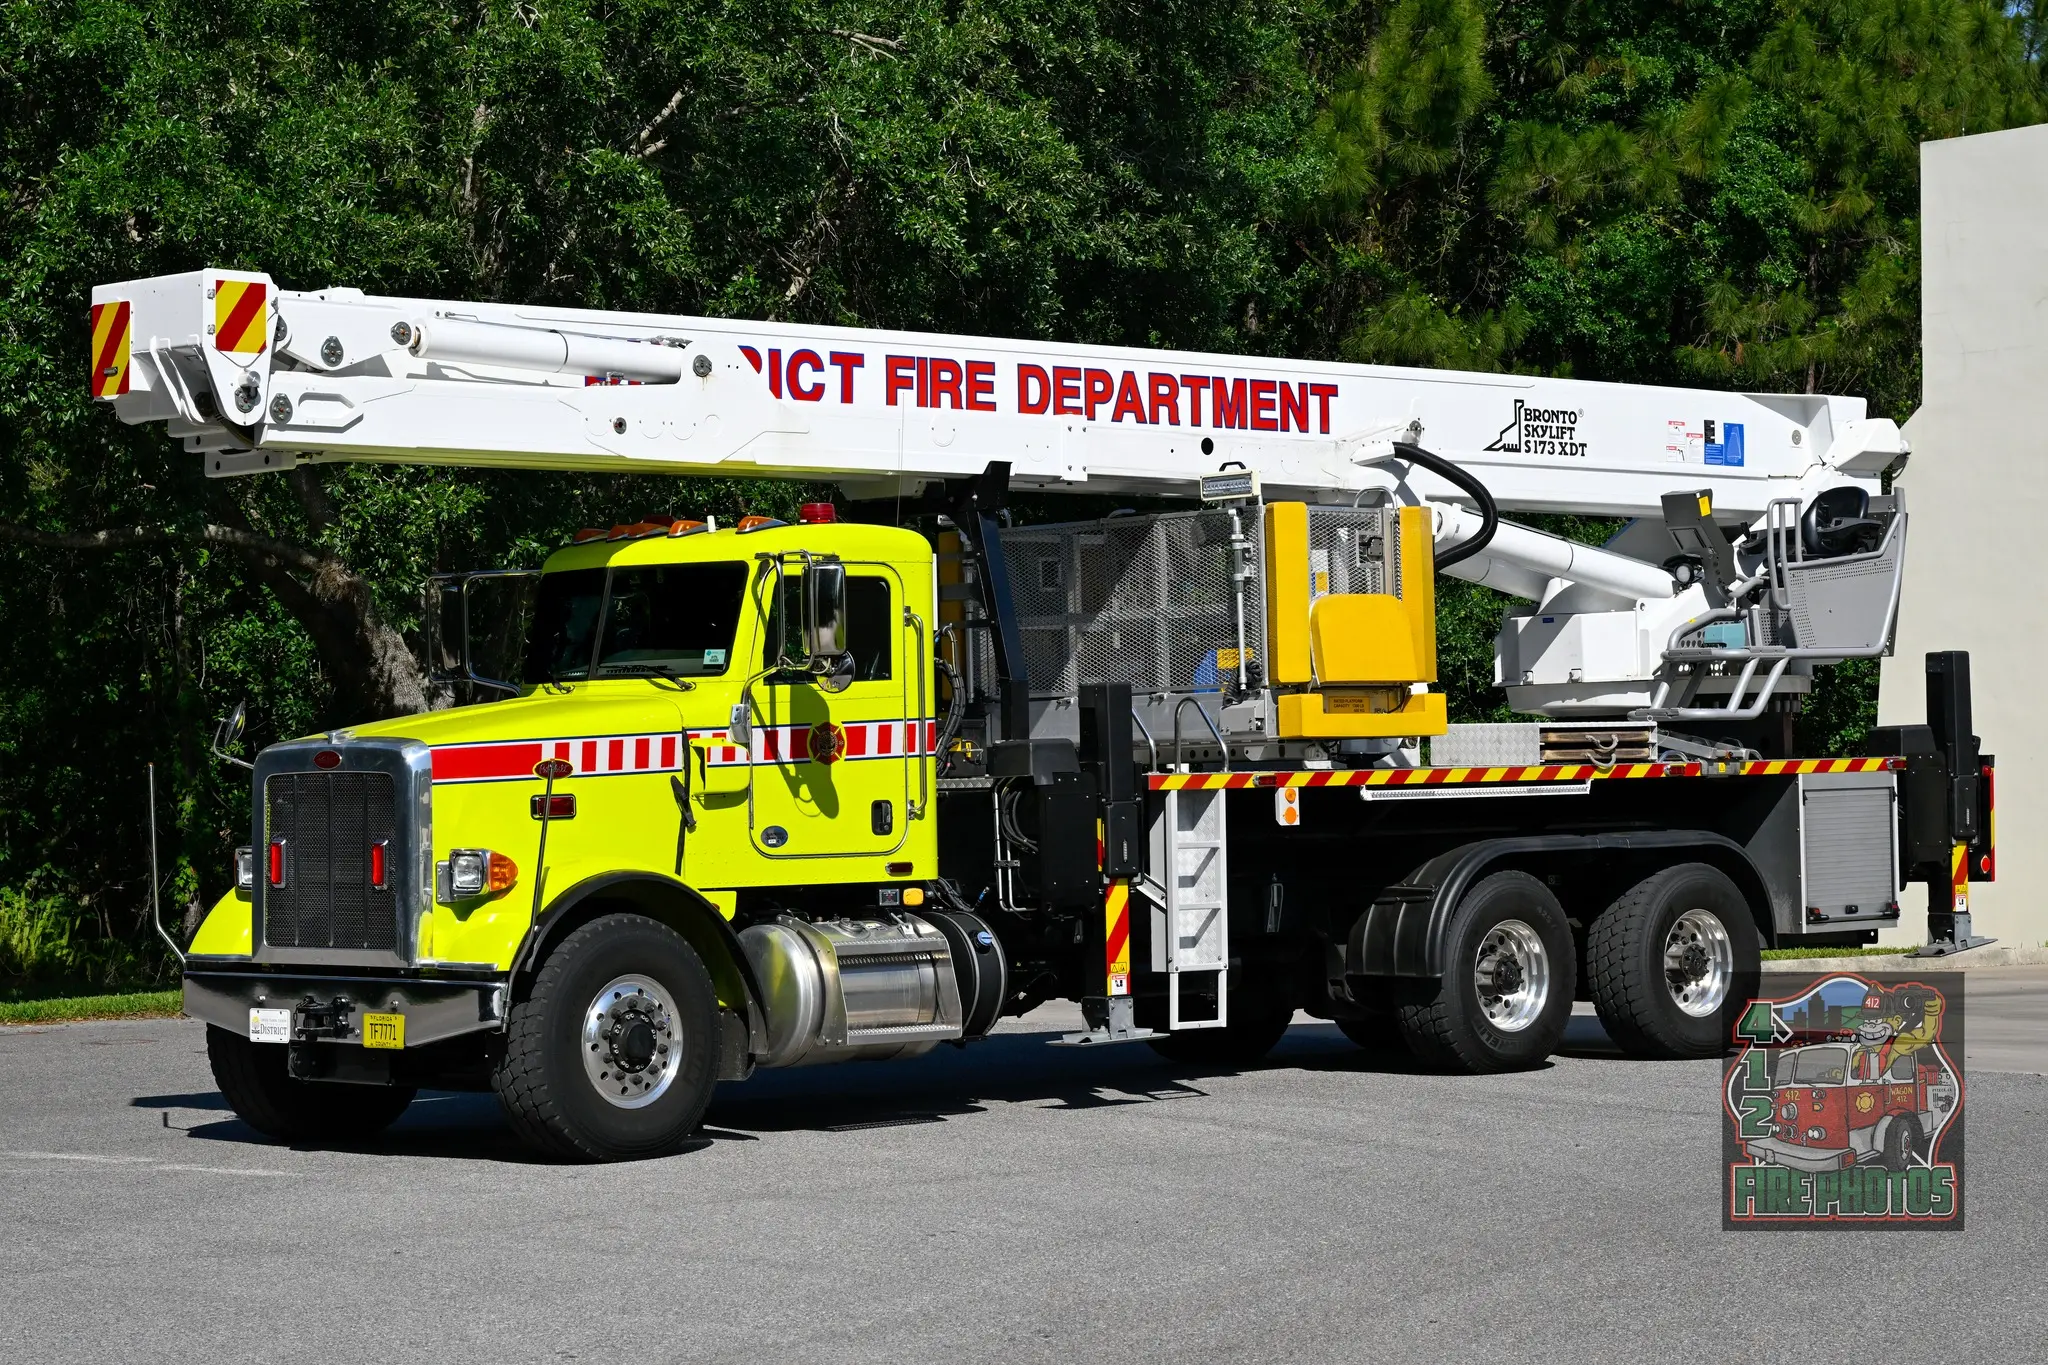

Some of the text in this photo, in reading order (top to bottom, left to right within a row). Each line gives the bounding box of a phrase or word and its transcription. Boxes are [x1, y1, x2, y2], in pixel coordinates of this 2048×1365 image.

[885, 354, 997, 412] FIRE
[1017, 363, 1339, 434] DEPARTMENT
[1524, 424, 1575, 440] SKYLIFT
[1558, 441, 1587, 456] XDT
[370, 1023, 397, 1041] TF7771
